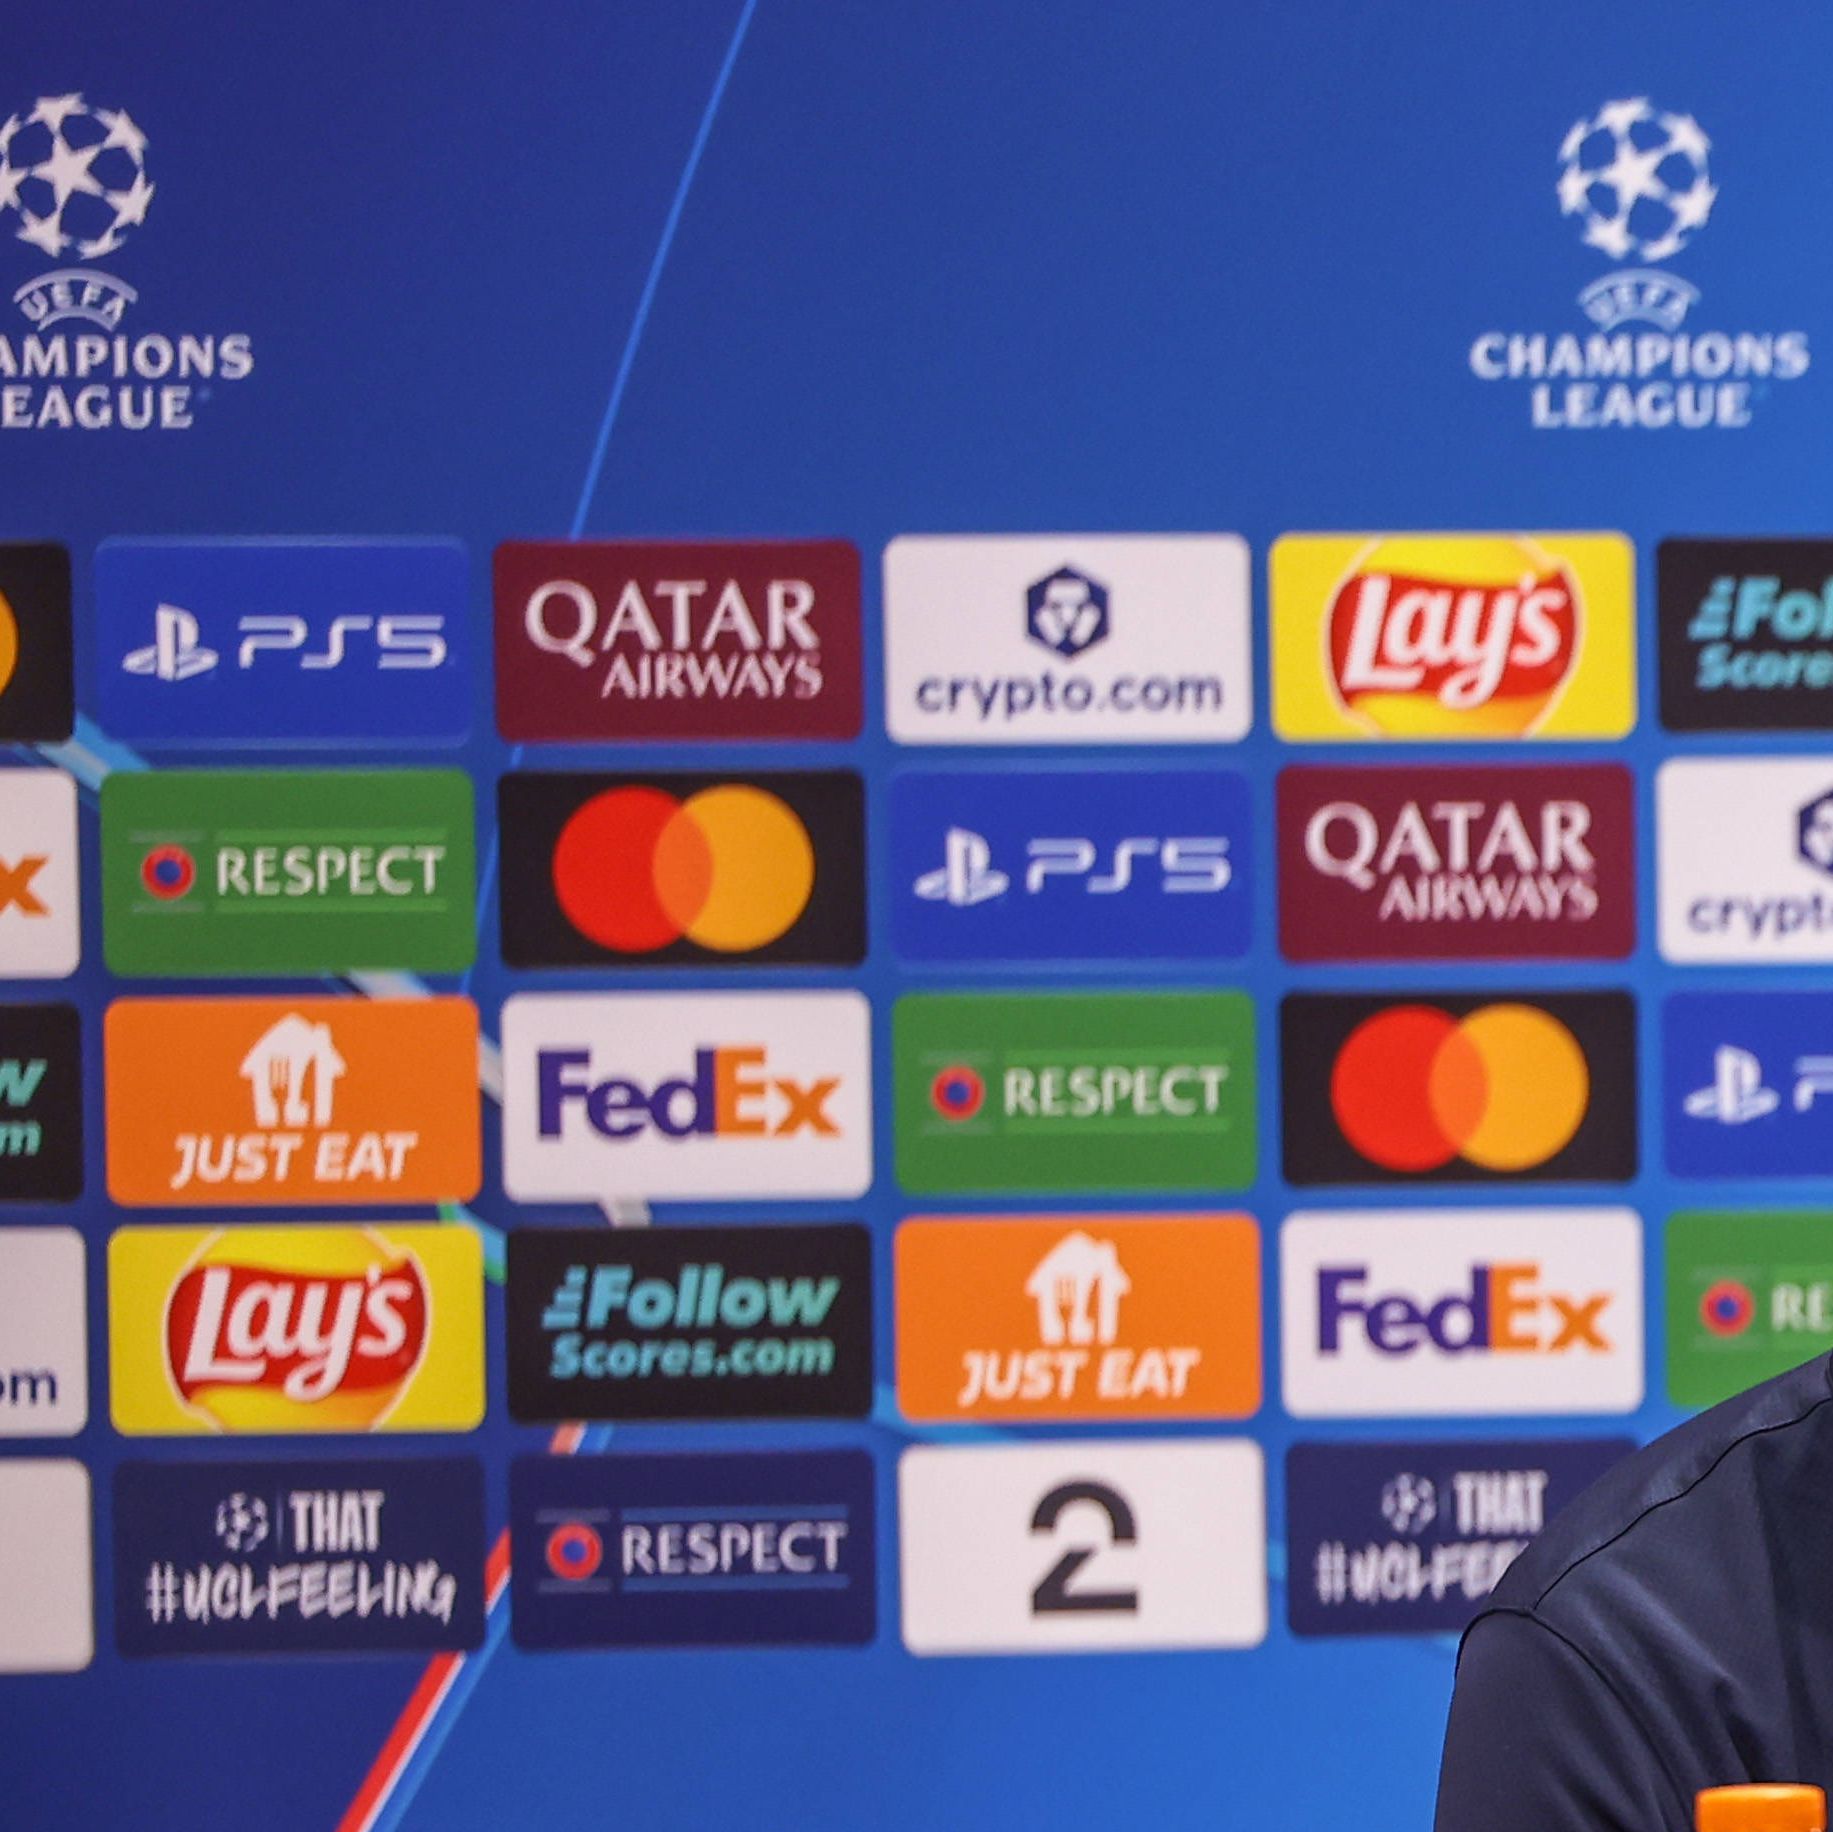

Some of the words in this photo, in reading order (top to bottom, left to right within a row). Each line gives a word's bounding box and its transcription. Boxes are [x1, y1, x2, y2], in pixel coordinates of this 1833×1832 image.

[1470, 332, 1810, 379] CHAMPIONS
[2, 385, 193, 429] EAGUE
[1532, 383, 1751, 429] LEAGUE
[238, 615, 447, 670] PS5
[525, 580, 819, 665] QATAR
[1343, 572, 1568, 710] Lay's
[601, 653, 822, 700] AIRWAYS
[915, 670, 1222, 721] crypto.com
[216, 846, 446, 897] RESPECT
[1025, 838, 1232, 894] PS5
[1306, 800, 1595, 888] QATAR
[1379, 874, 1598, 922] AIRWAYS
[538, 1045, 841, 1140] FedEx
[1004, 1066, 1229, 1117] RESPECT
[170, 1135, 298, 1190] JUST
[314, 1132, 417, 1181] EAT
[587, 1265, 840, 1330] Follow
[1316, 1262, 1615, 1355] FedEx
[185, 1267, 411, 1401] Lay's
[551, 1334, 834, 1378] Scores.com
[958, 1352, 1085, 1406] JUST
[1098, 1350, 1200, 1398] EAT
[290, 1492, 385, 1553] THAT
[622, 1523, 848, 1573] RESPECT
[1030, 1476, 1138, 1617] 2
